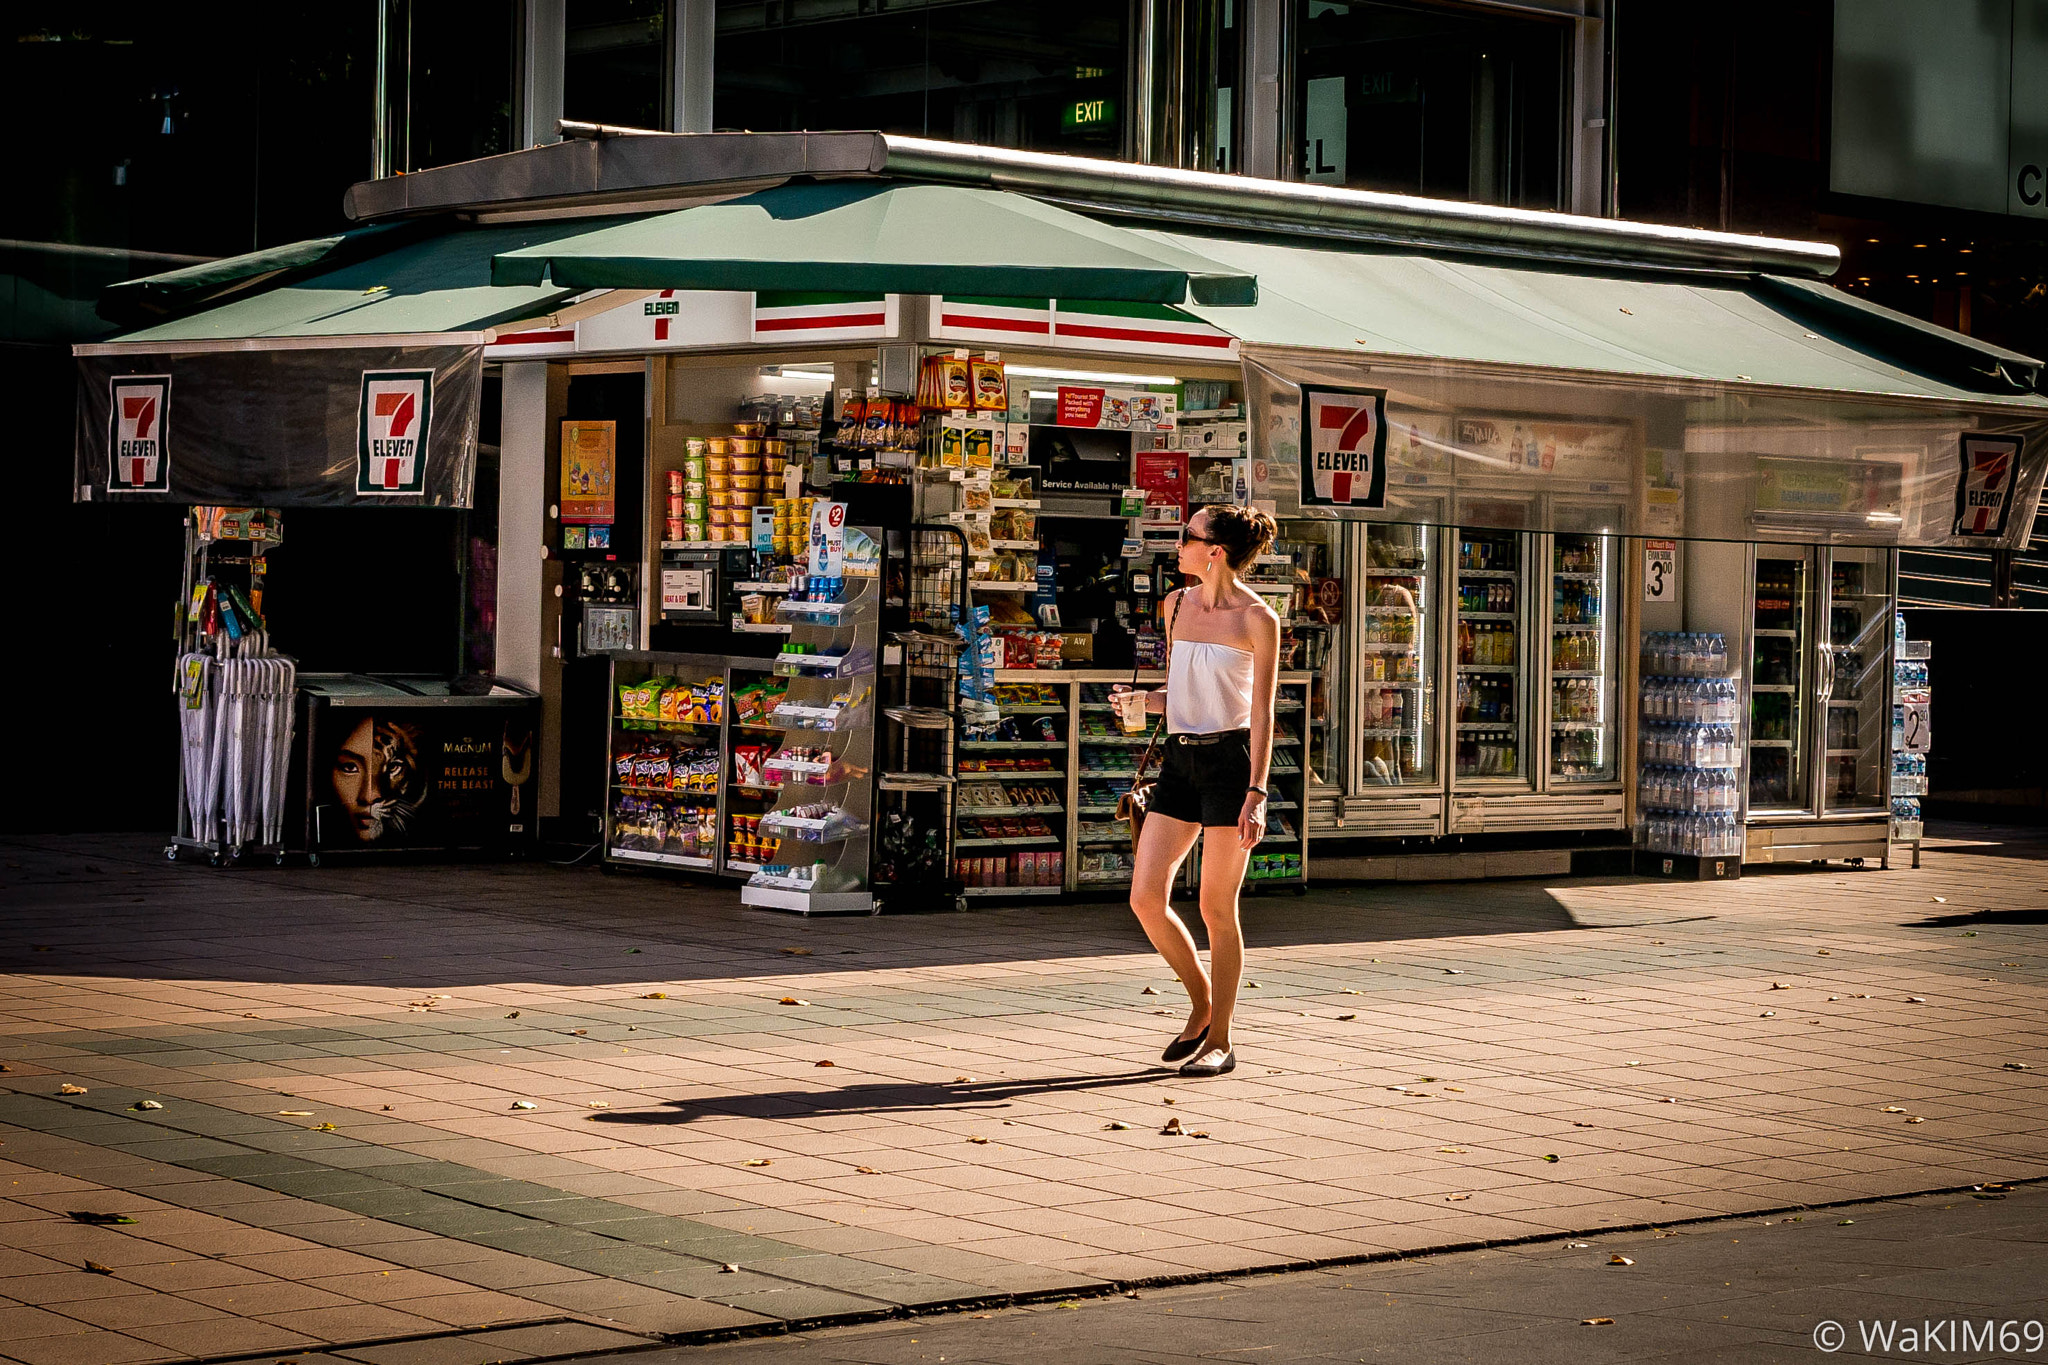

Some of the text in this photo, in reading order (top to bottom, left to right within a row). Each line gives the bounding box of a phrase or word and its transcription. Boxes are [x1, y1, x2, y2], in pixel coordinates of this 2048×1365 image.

[1363, 72, 1394, 95] EXIT
[1076, 101, 1104, 123] EXIT
[2017, 164, 2048, 207] C
[1042, 480, 1072, 489] Service
[1074, 481, 1109, 490] Available
[831, 507, 841, 522] $2
[758, 534, 771, 543] HOT
[1666, 541, 1675, 550] Buy
[664, 595, 674, 603] HEAT
[443, 742, 492, 753] MAGNUM
[444, 767, 488, 776] RELEASE
[438, 780, 493, 790] THE BEAST
